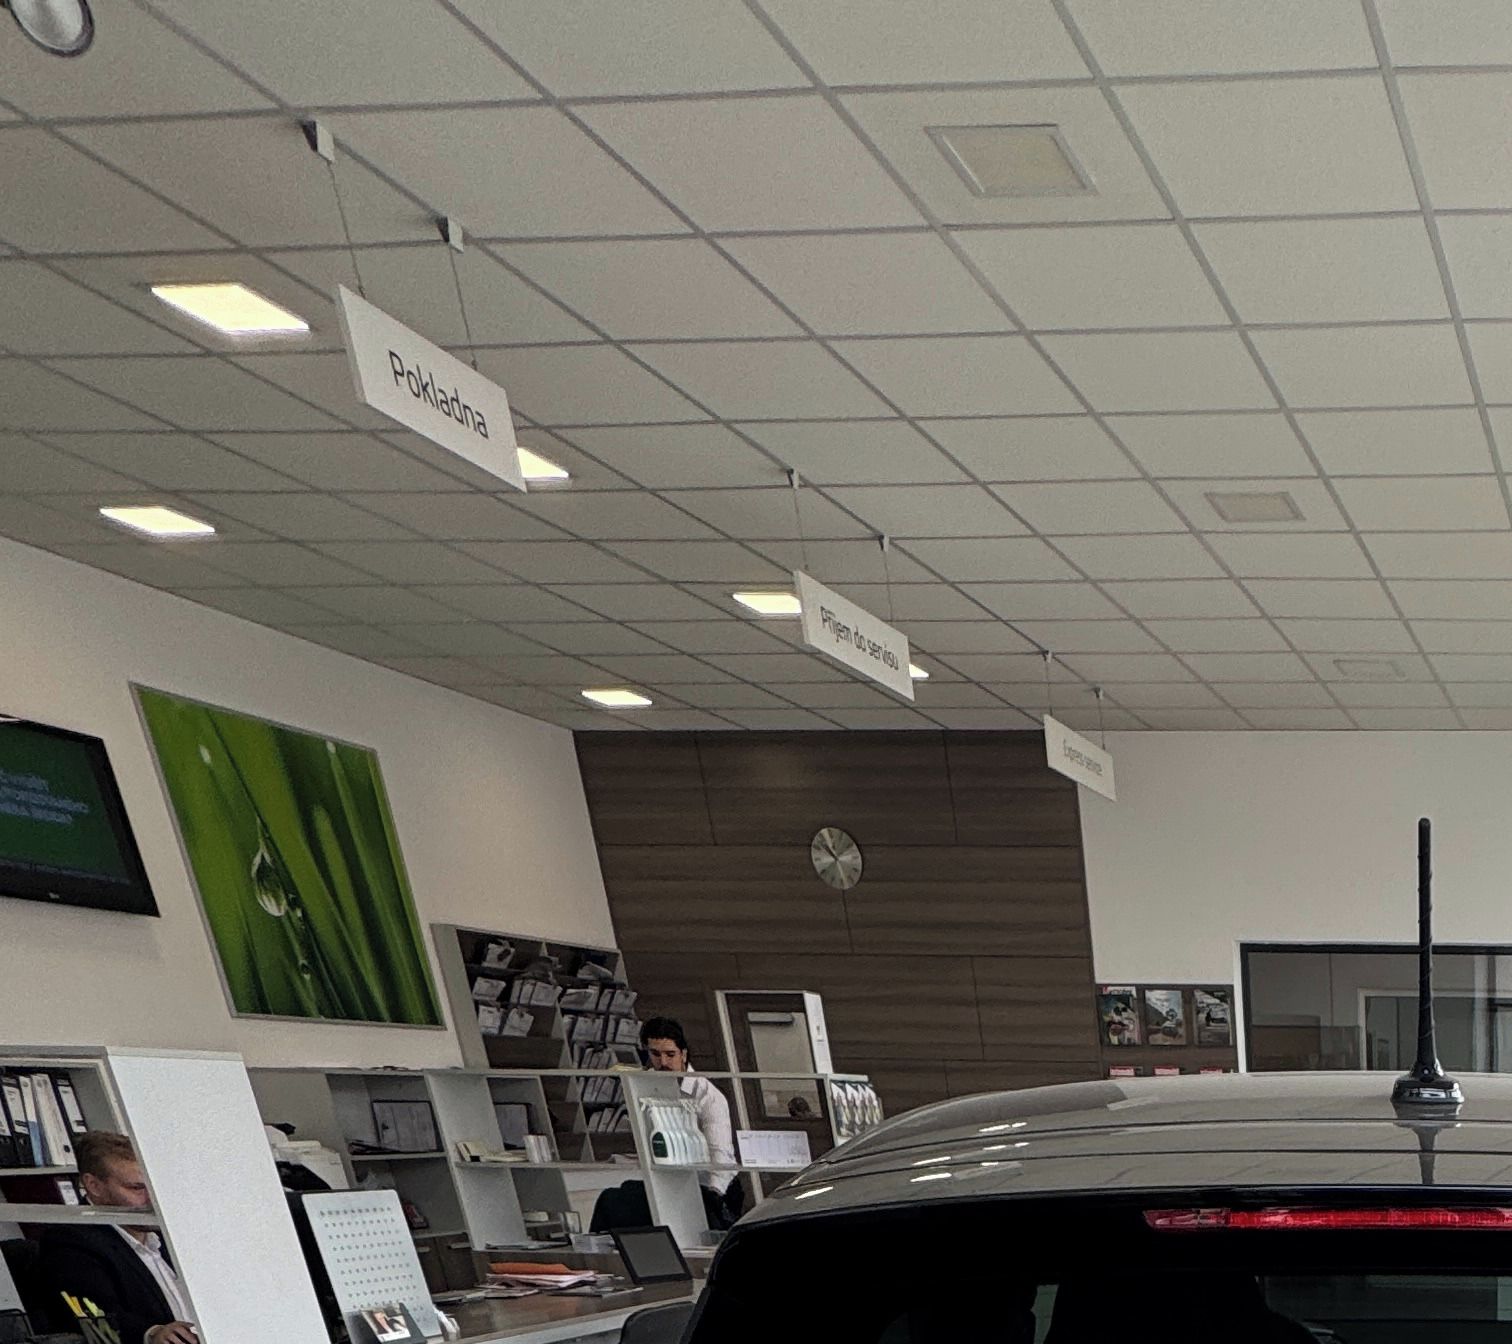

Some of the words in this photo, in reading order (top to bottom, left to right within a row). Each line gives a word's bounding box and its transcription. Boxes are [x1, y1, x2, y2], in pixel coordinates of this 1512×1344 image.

[388, 350, 489, 439] Pokladna
[854, 624, 867, 652] do
[867, 638, 899, 670] servisu
